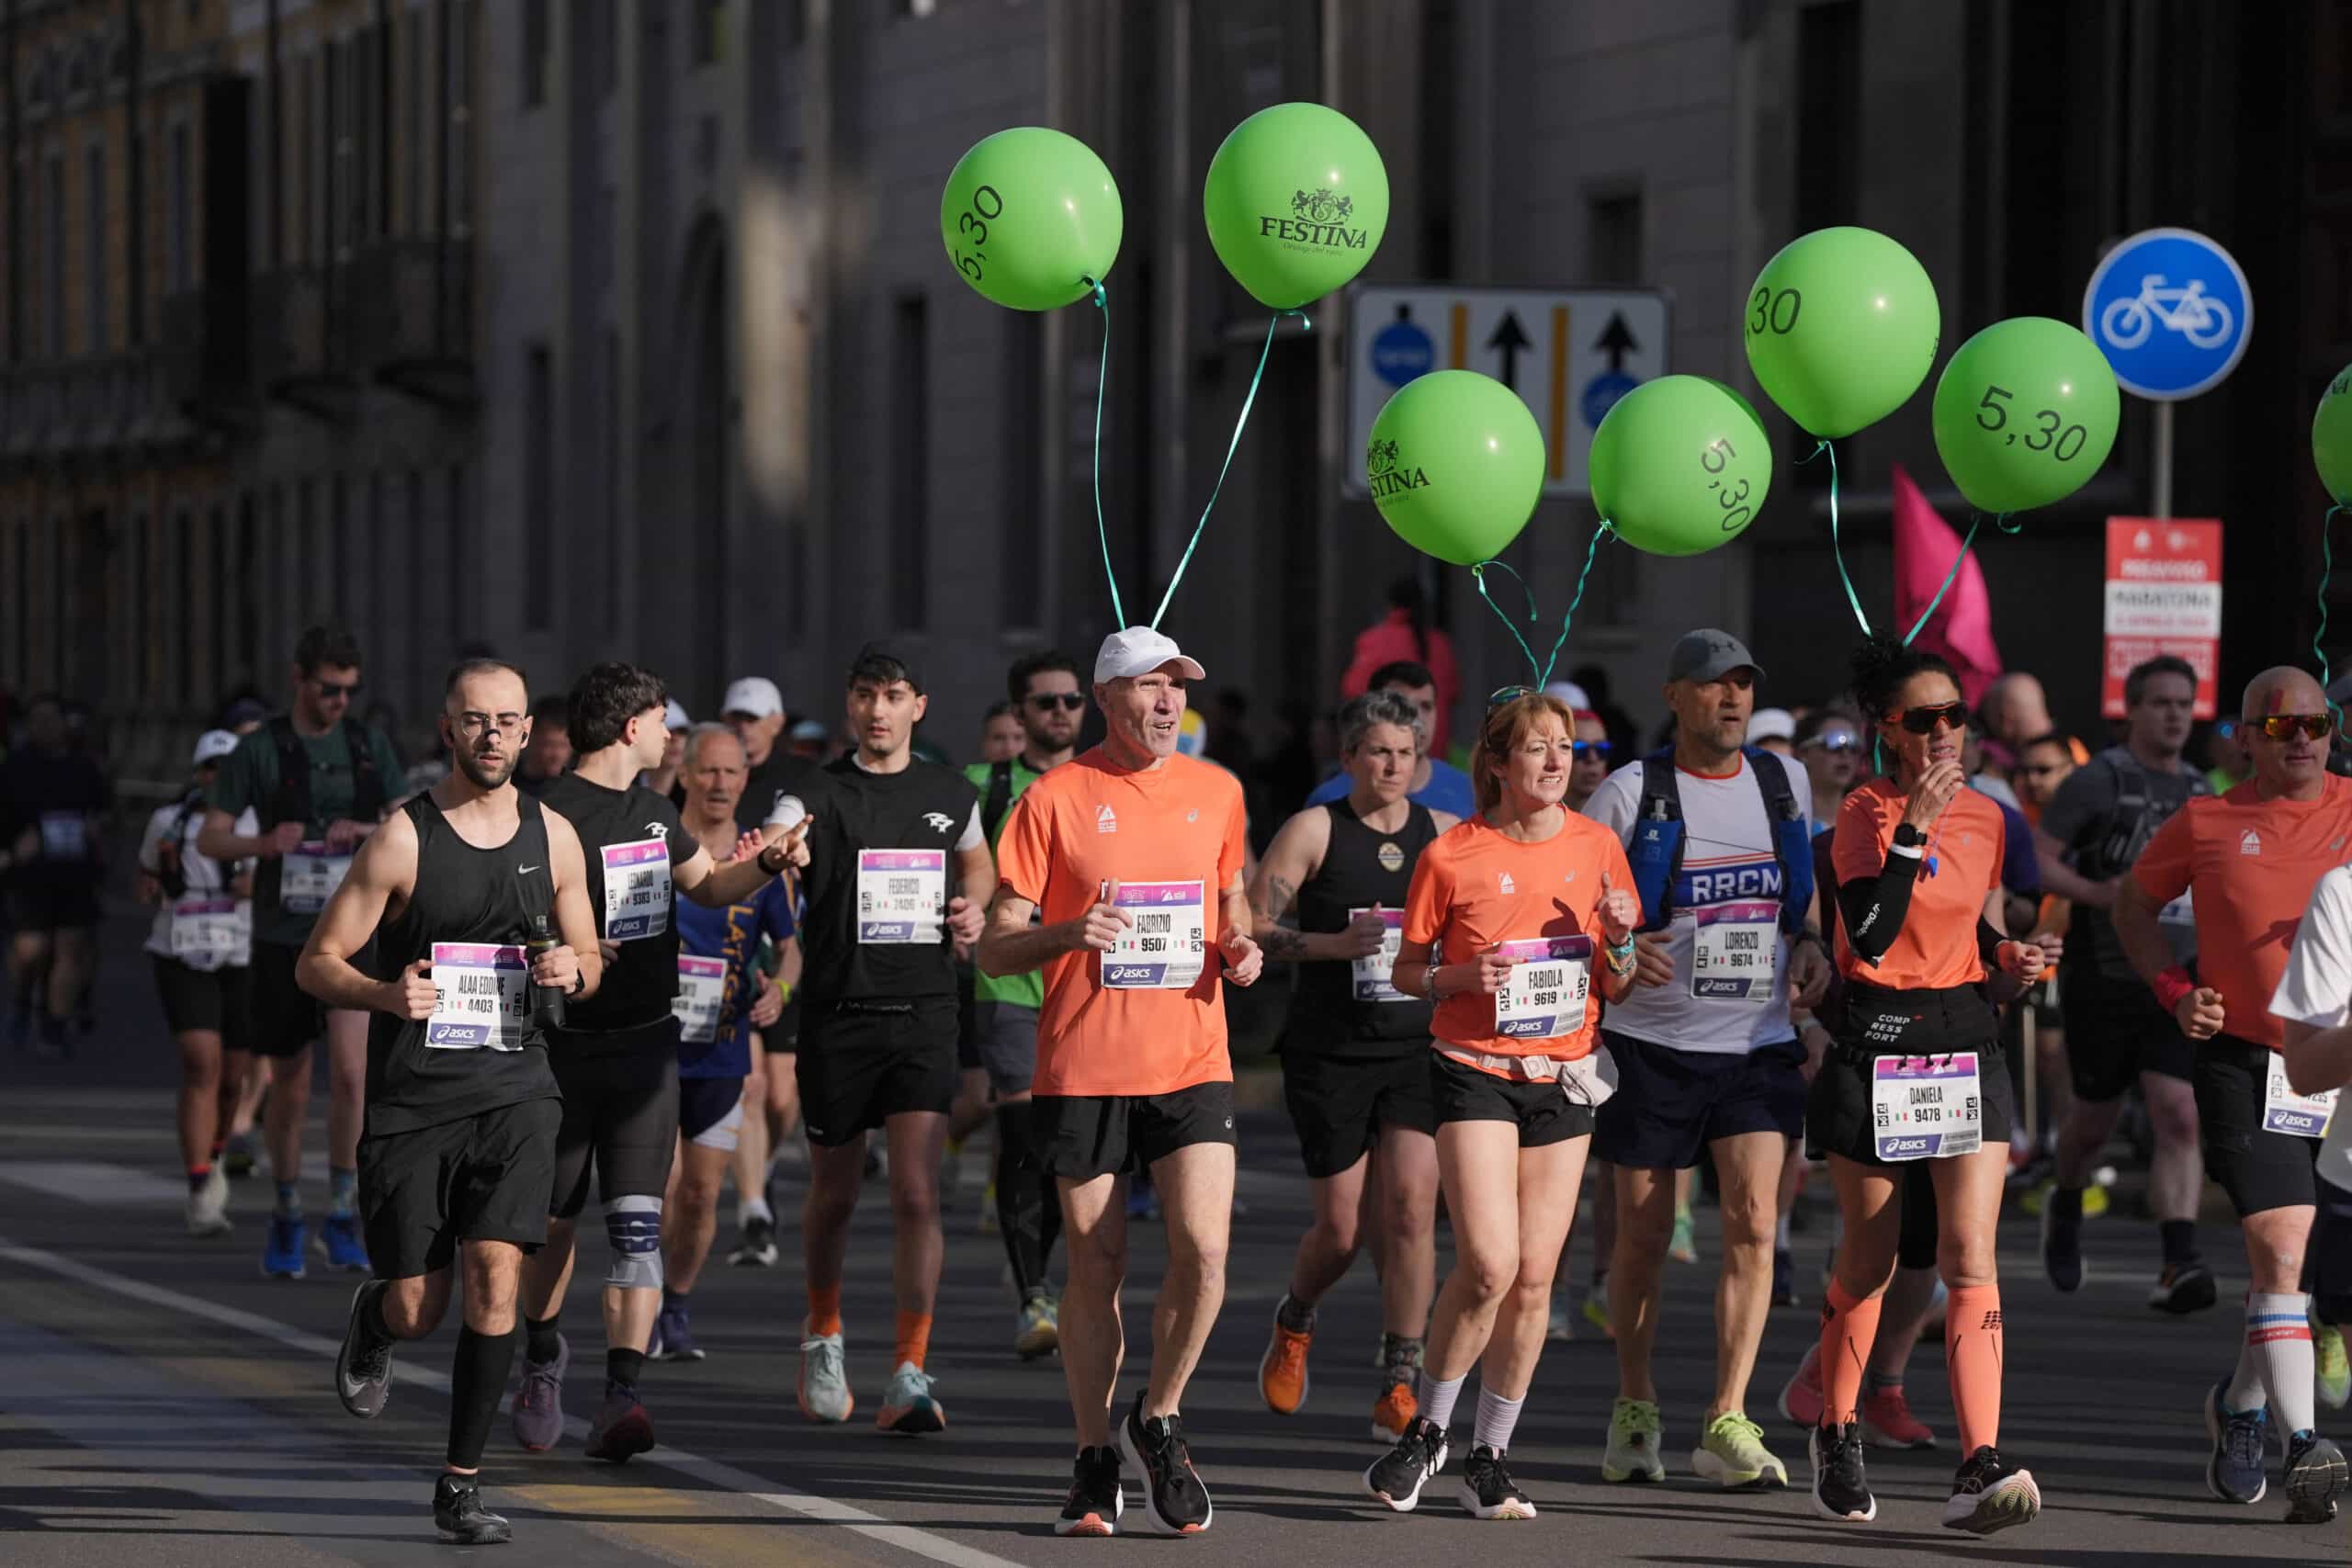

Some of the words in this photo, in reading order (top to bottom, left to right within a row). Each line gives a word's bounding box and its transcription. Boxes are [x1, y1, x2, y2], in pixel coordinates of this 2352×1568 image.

[1260, 216, 1367, 249] FESTINA
[1976, 385, 2086, 461] 5,30
[1702, 438, 1750, 531] 5,30
[1691, 868, 1782, 903] RRCM
[1137, 913, 1170, 933] FABRIZIO
[1141, 938, 1167, 952] 9507
[1724, 931, 1758, 950] LORENZO
[1731, 953, 1753, 966] 9674
[458, 975, 477, 994] ALAA
[479, 976, 505, 996] EDDINE
[1529, 968, 1563, 989] FABIOLA
[468, 999, 493, 1013] 4403
[1534, 991, 1557, 1006] 9619
[1871, 1022, 1903, 1033] RESS
[1878, 1014, 1911, 1024] COMP
[1864, 1031, 1898, 1043] PORT
[1910, 1086, 1943, 1105] DANIELA
[1915, 1108, 1941, 1122] 9478
